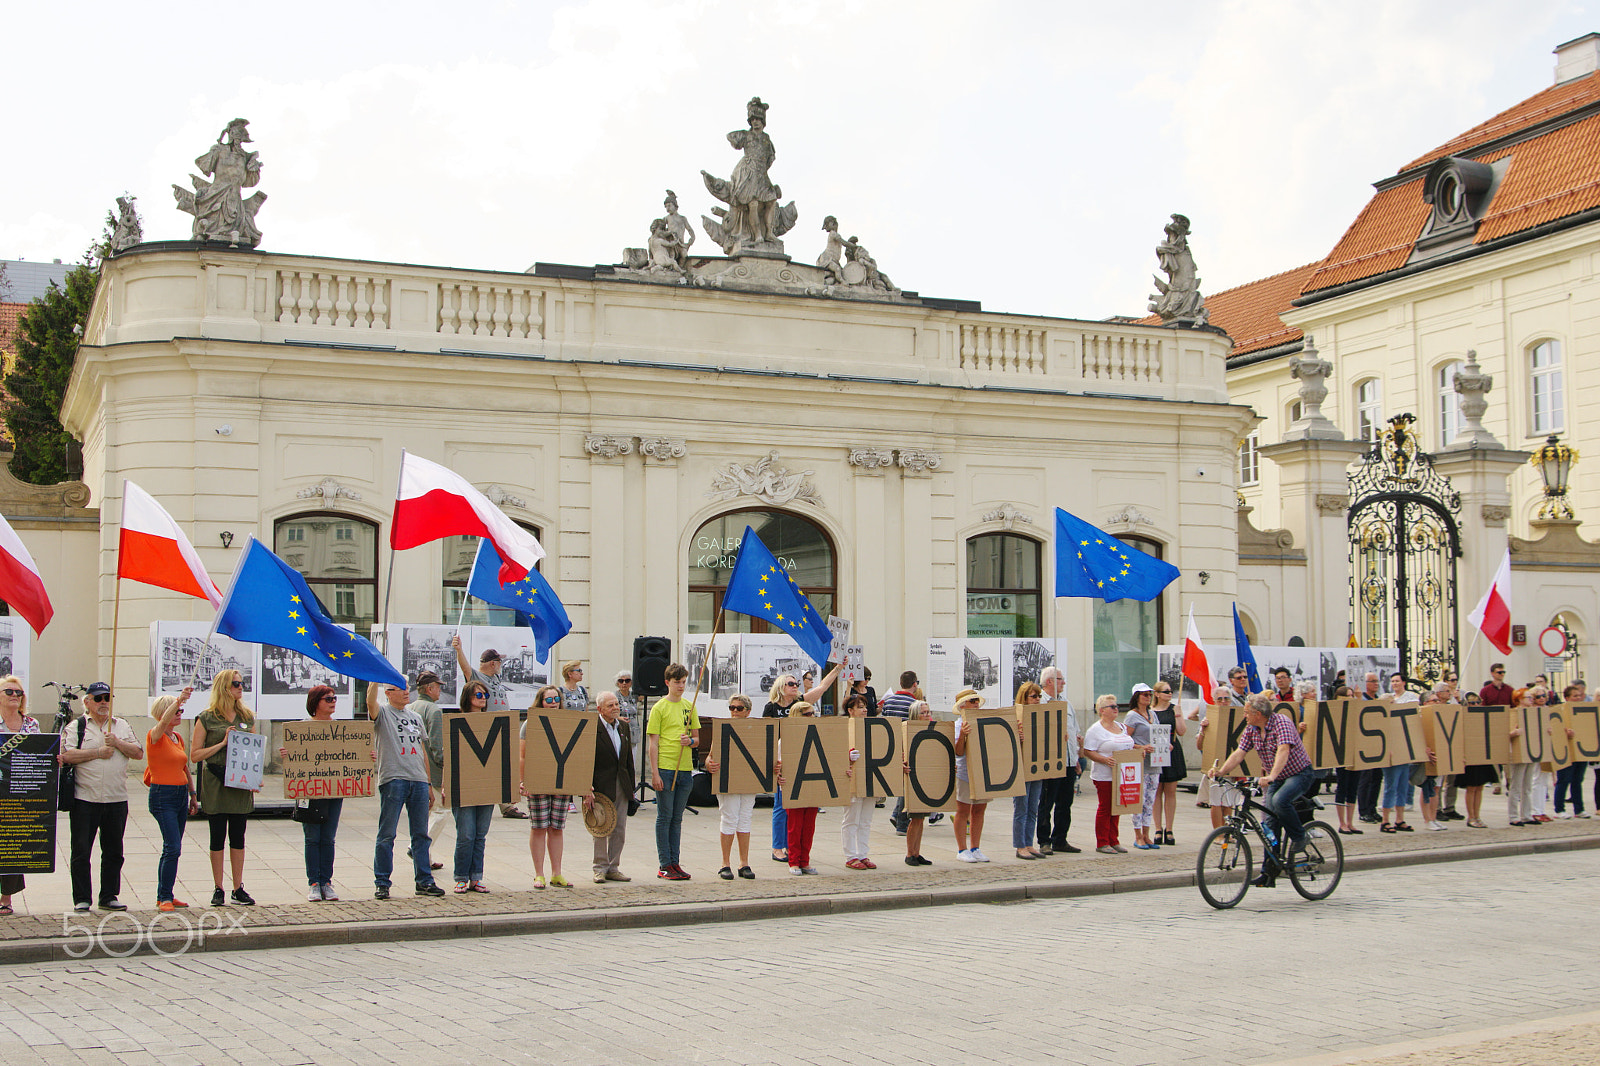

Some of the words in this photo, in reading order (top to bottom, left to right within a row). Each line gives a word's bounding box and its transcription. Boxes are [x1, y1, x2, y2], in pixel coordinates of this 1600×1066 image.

[697, 554, 797, 570] KORDDA
[830, 619, 849, 631] KON
[831, 629, 847, 641] TY
[833, 641, 845, 651] UC
[781, 663, 800, 673] KON
[232, 734, 262, 748] KON
[284, 728, 298, 742] Die
[299, 726, 331, 746] polnische
[329, 724, 372, 746] Verfassung
[231, 747, 260, 761] STY
[288, 748, 309, 762] wird
[314, 748, 360, 766] gebrochen.
[400, 747, 418, 756] JA
[231, 760, 259, 773] TUC
[308, 766, 341, 780] polnischen
[229, 773, 248, 784] JA
[287, 779, 332, 799] SAGEN
